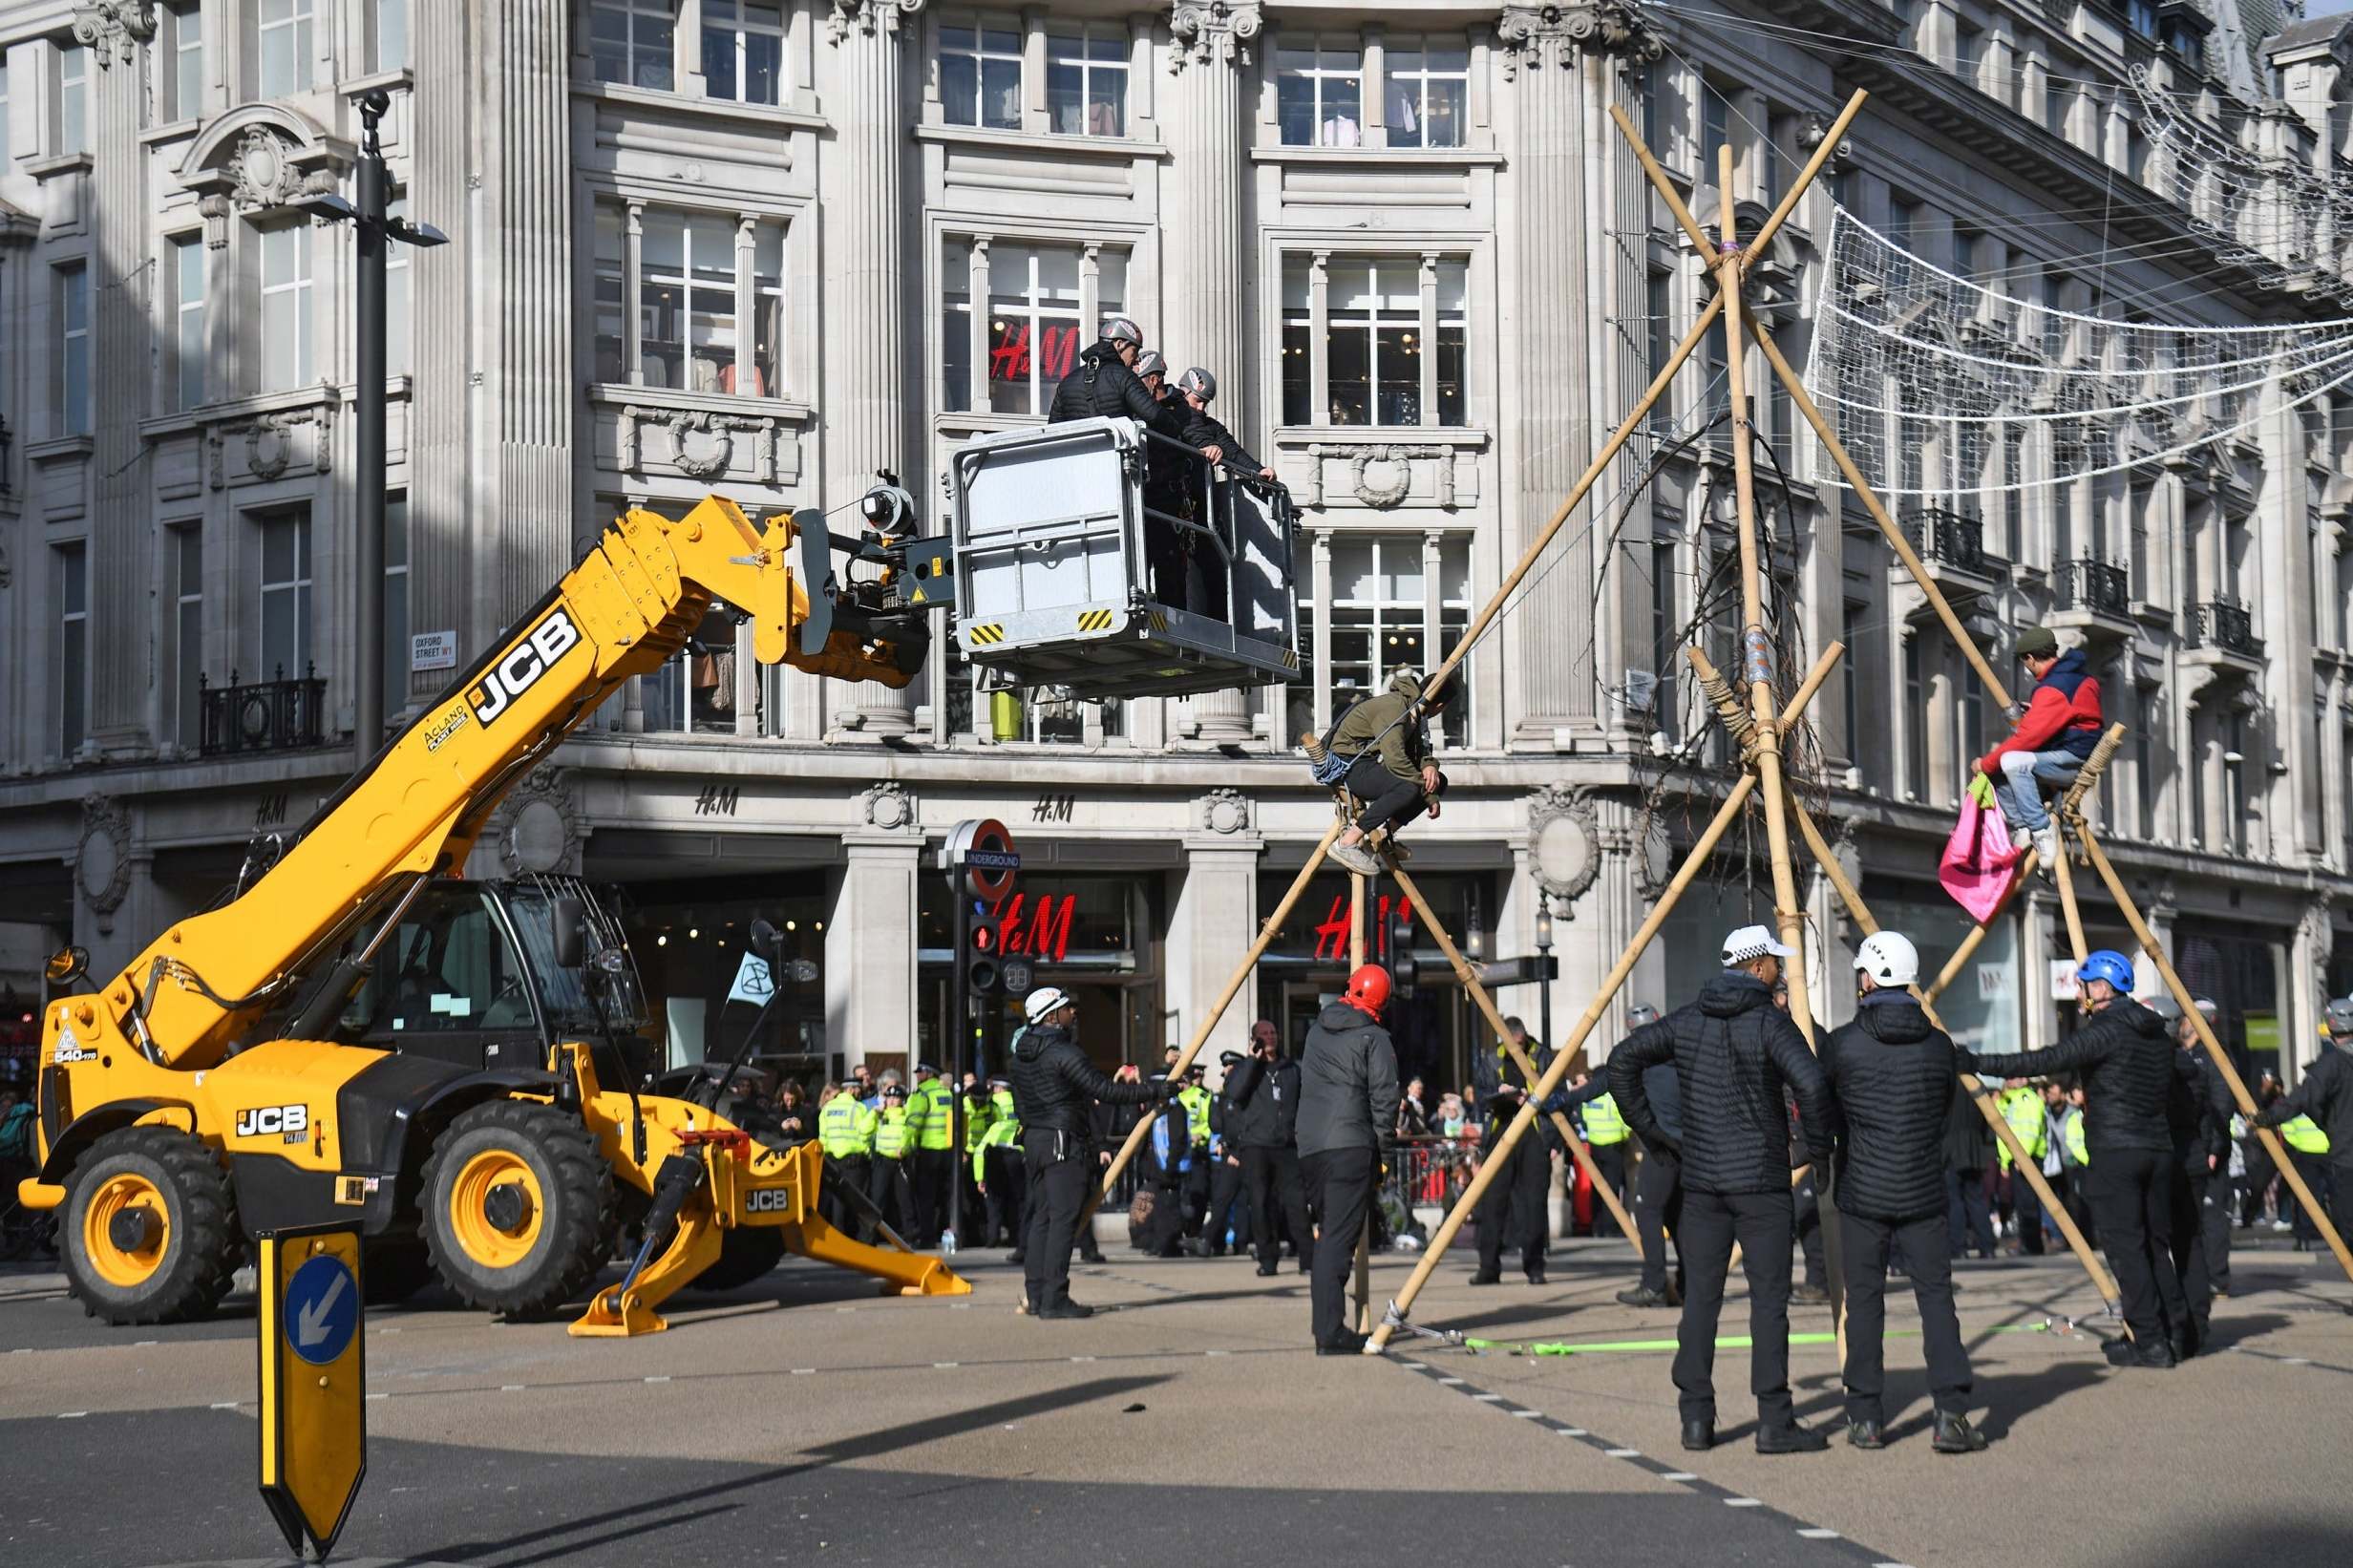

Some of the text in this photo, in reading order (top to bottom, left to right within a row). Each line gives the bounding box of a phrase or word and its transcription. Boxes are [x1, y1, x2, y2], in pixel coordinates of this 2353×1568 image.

[414, 636, 442, 648] OXFORD
[414, 647, 440, 659] STREET
[476, 612, 577, 723] JCB
[694, 785, 740, 817] H&M
[1031, 794, 1076, 824] H&M
[966, 853, 1019, 866] UNDERGROUND
[237, 1105, 307, 1137] JCB
[747, 1189, 788, 1212] JCB
